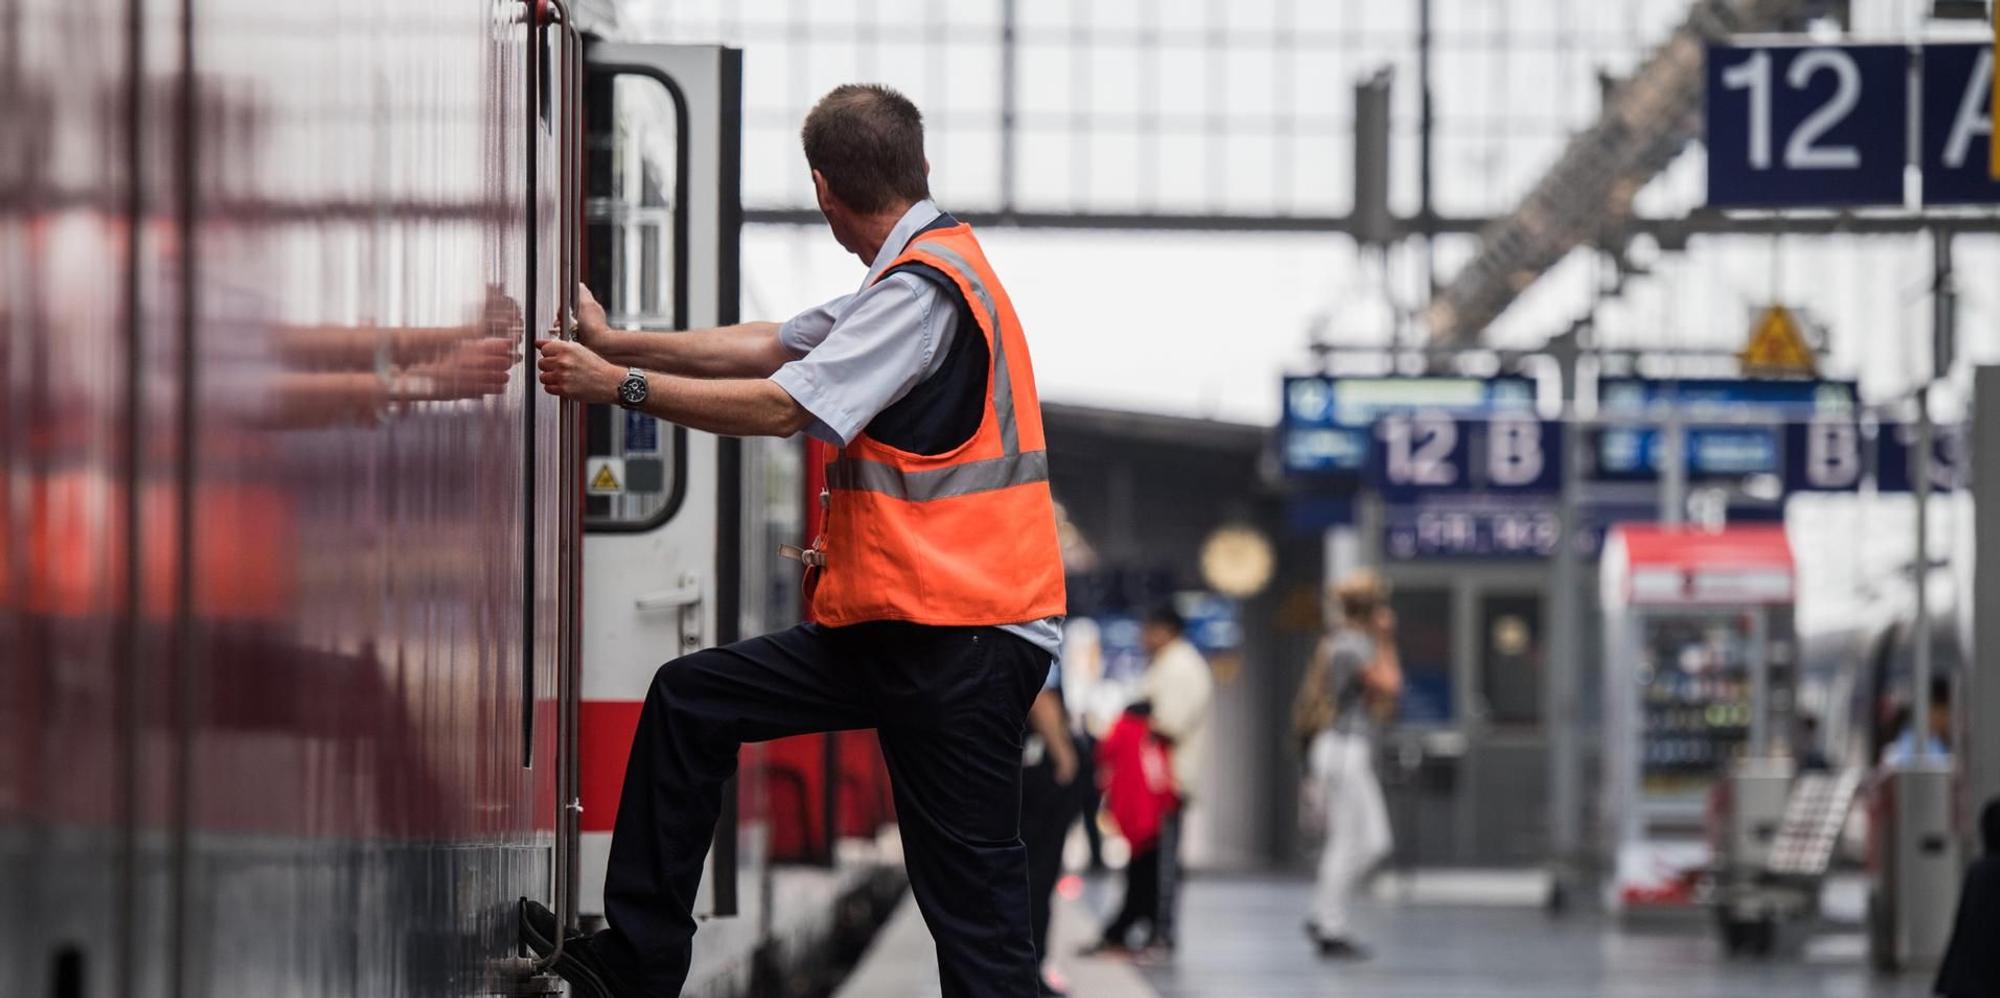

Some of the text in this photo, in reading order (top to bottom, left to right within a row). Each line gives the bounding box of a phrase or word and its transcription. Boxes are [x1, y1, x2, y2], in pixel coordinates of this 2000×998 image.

[1721, 49, 1861, 169] 12
[1377, 411, 1458, 485] 12
[1487, 411, 1543, 485] B
[1807, 413, 1859, 488] B
